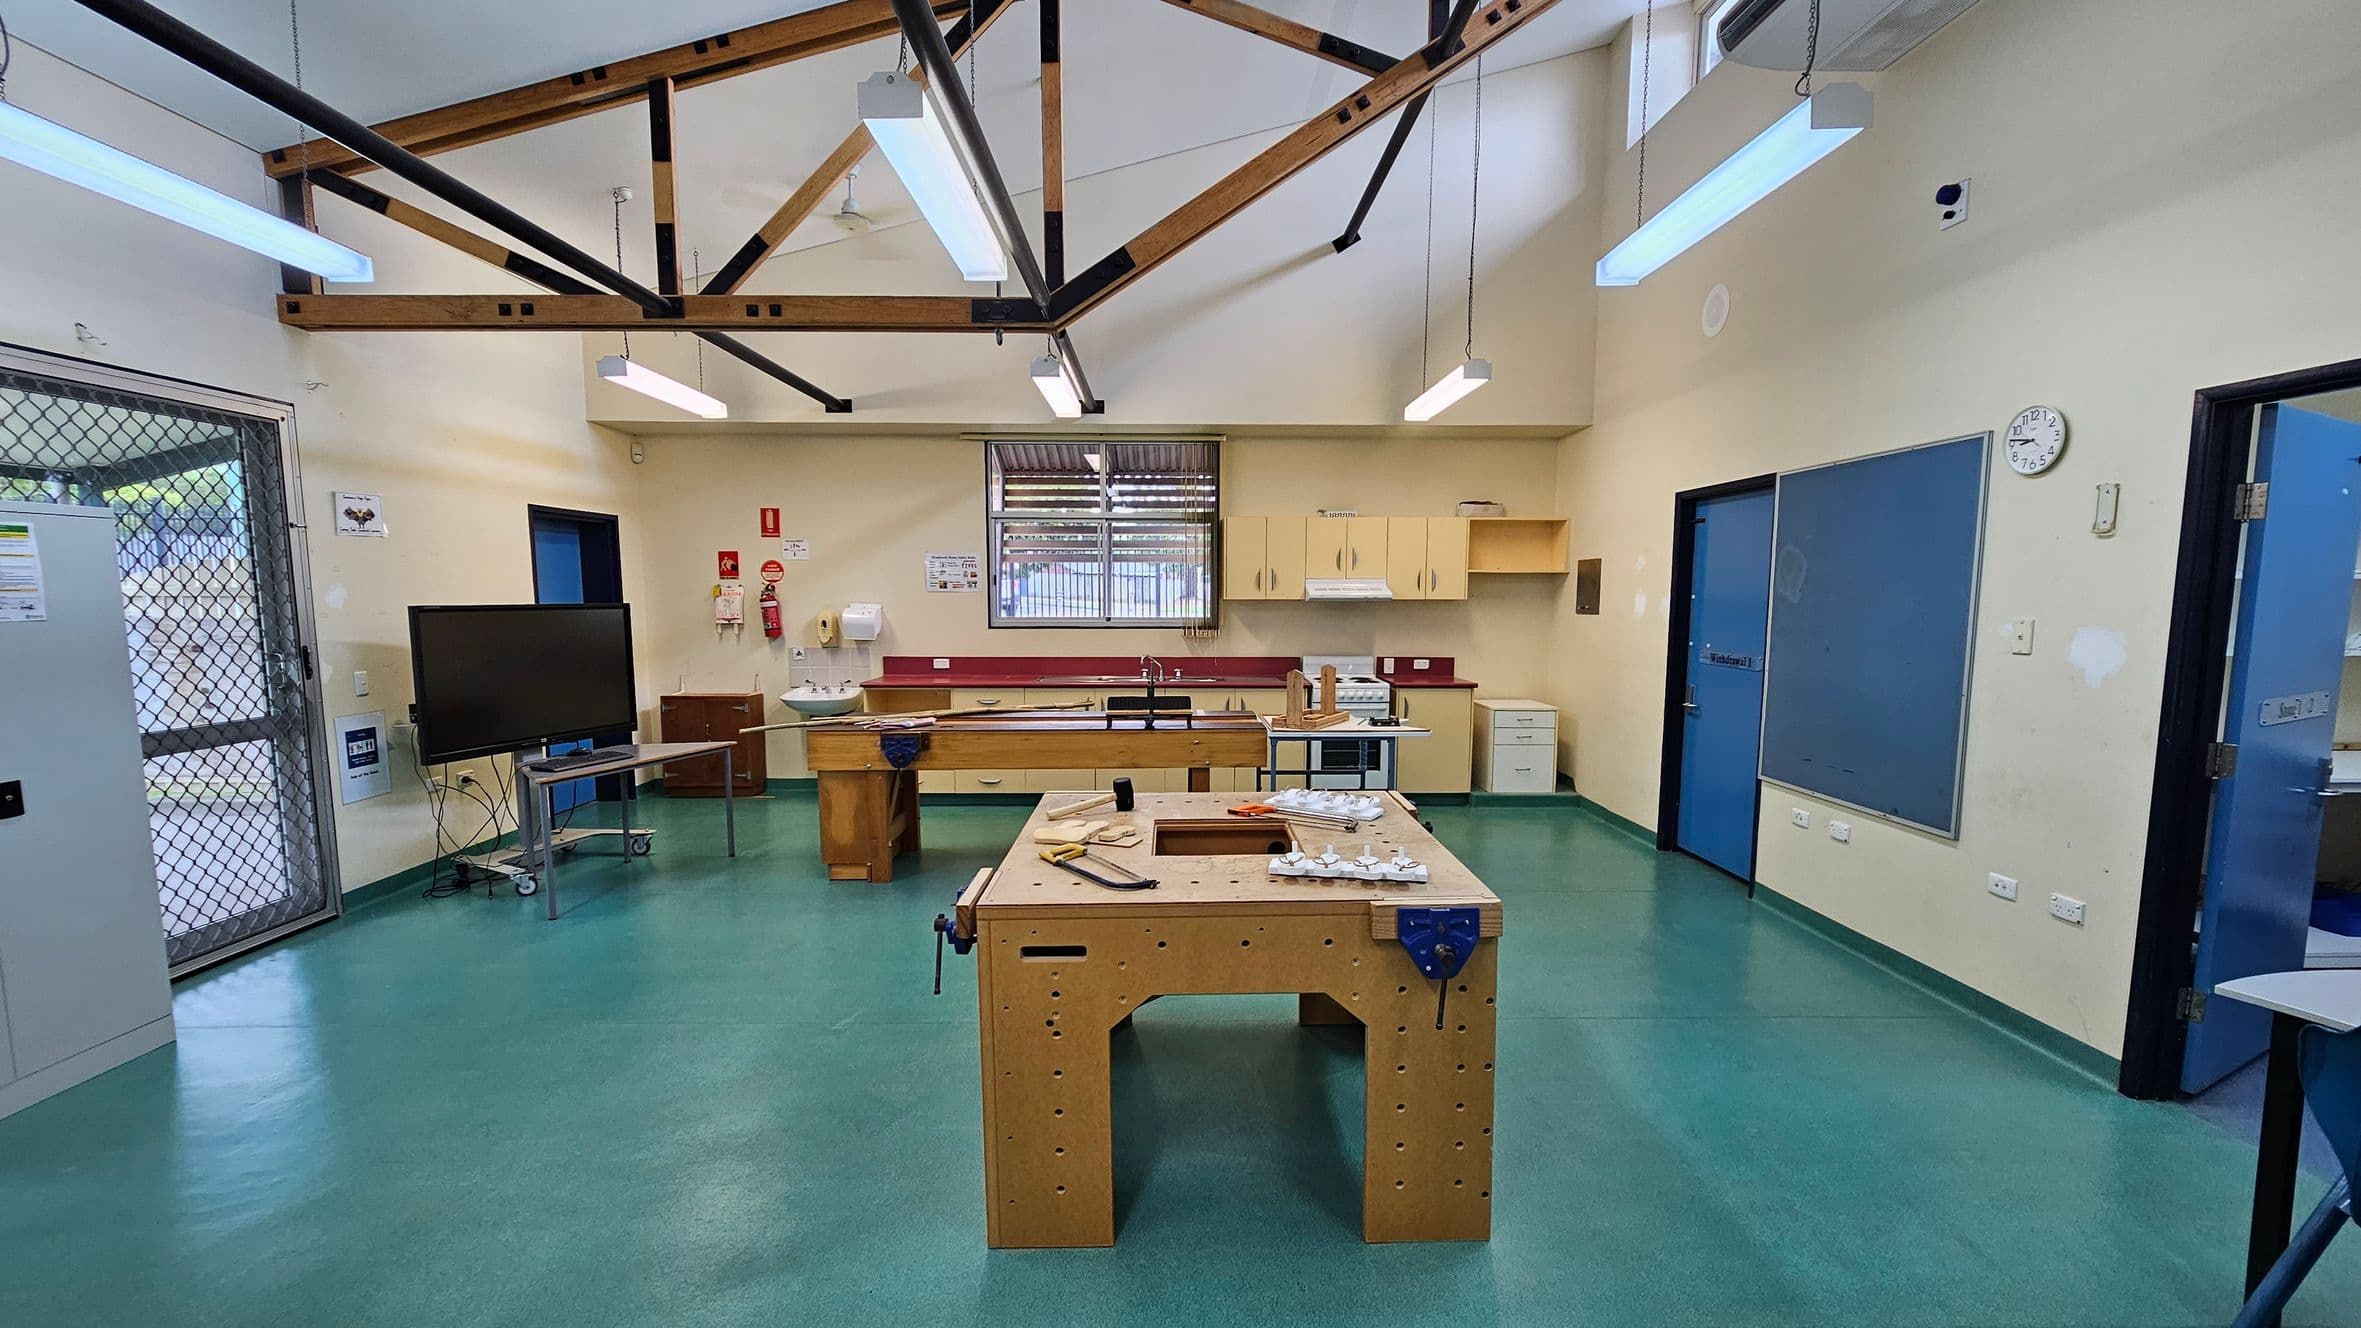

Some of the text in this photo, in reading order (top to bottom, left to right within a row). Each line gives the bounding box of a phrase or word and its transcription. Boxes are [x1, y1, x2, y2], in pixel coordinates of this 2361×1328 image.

[2022, 414, 2029, 426] 11
[2030, 409, 2040, 421] 12
[2043, 410, 2047, 421] 1
[2048, 415, 2057, 428] 2
[2012, 424, 2023, 437] 10
[2053, 429, 2060, 442] 3
[2008, 439, 2016, 450] 9
[2047, 445, 2054, 455] 4
[2011, 451, 2019, 463] 8
[2021, 457, 2028, 469] 7
[2039, 454, 2047, 467] 5
[2029, 458, 2037, 470] 6
[1710, 652, 1747, 667] Withdrawal
